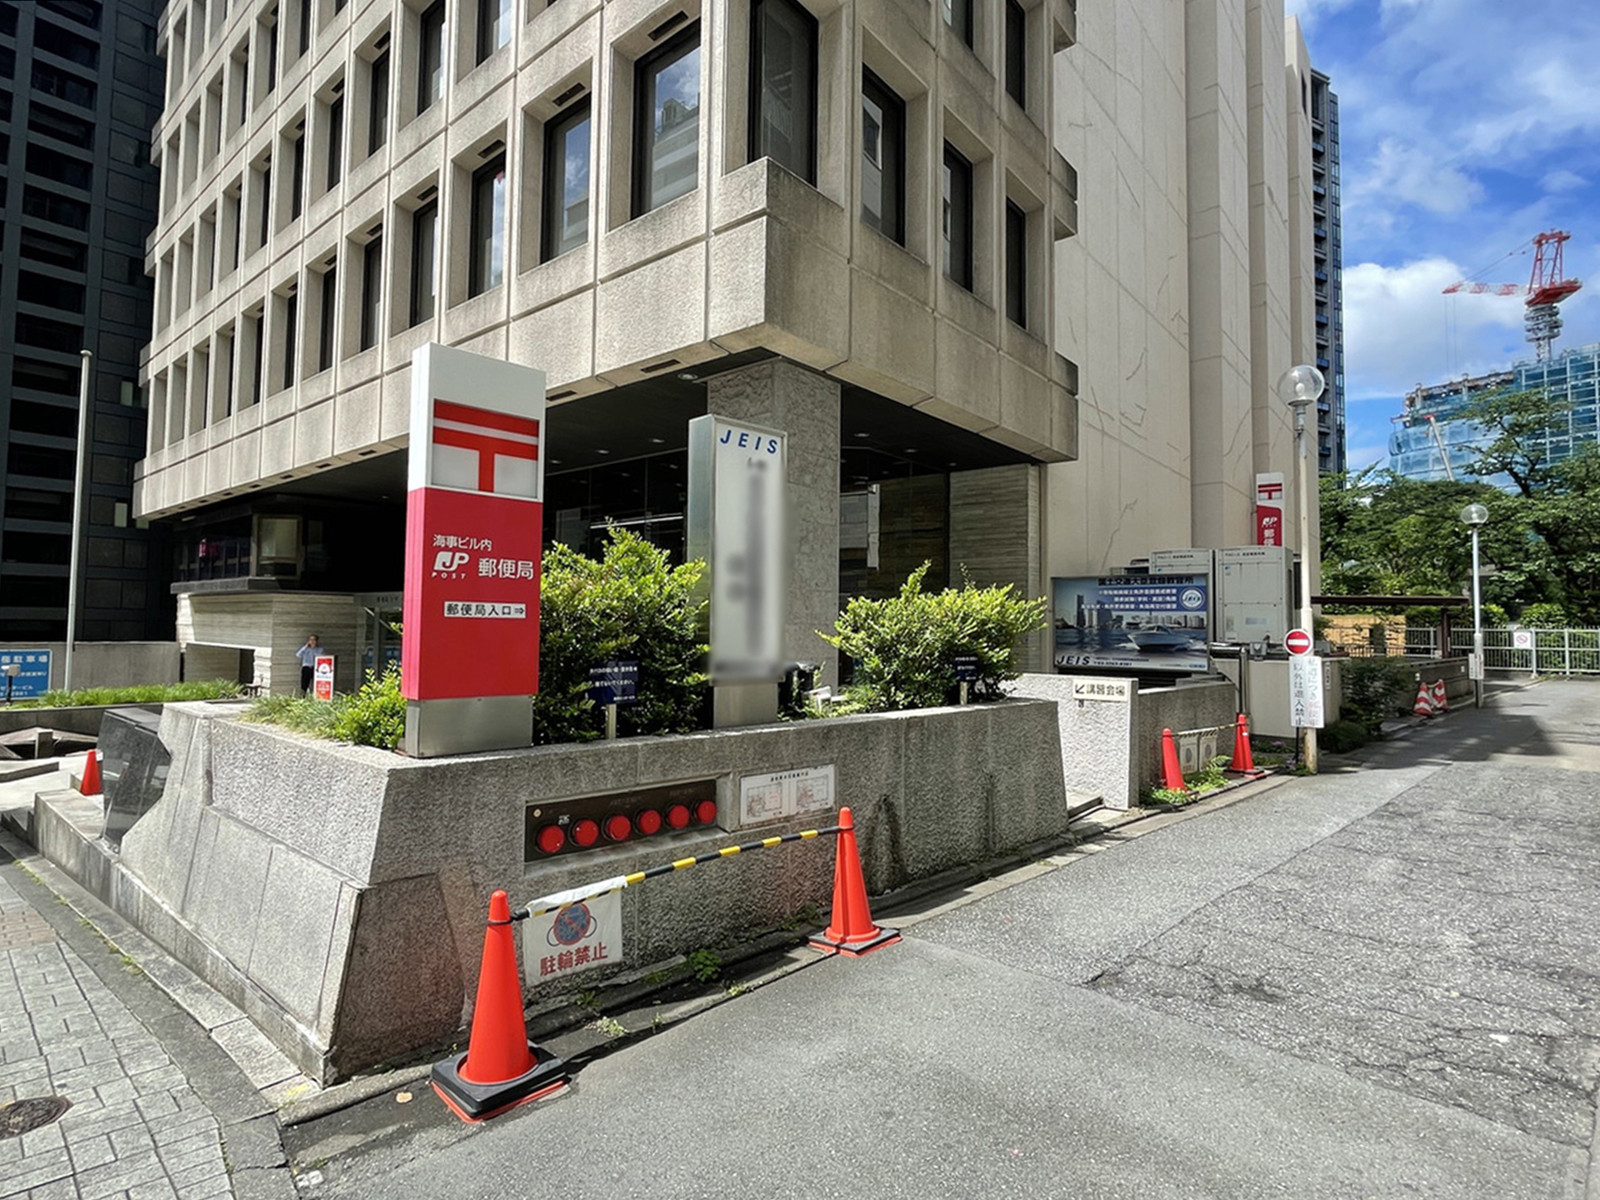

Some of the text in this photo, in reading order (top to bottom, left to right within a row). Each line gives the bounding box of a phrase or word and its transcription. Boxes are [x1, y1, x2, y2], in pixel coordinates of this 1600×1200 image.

[720, 429, 778, 454] JEIS
[433, 534, 492, 552] 海事ビル内
[431, 571, 466, 579] POST
[478, 557, 534, 580] 郵便局
[446, 603, 512, 617] 郵便局入口
[1056, 655, 1090, 666] JEIS
[540, 942, 608, 977] 駐輪禁止
